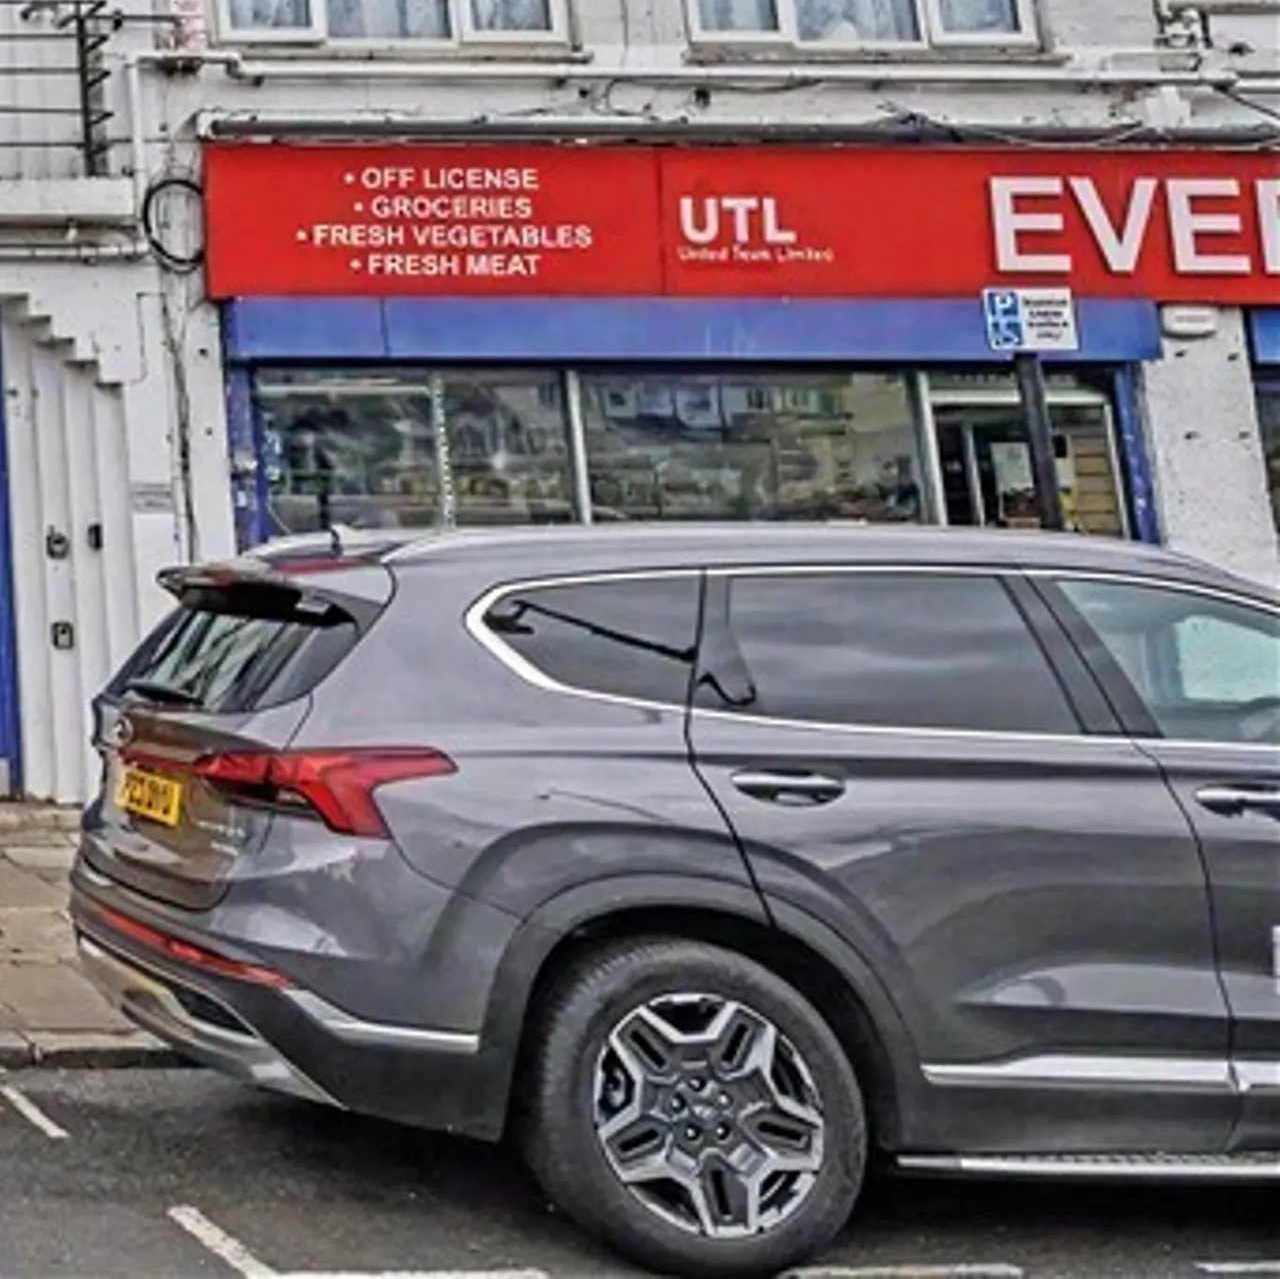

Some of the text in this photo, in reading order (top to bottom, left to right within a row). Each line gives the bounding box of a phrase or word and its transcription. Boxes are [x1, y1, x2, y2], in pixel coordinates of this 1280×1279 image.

[360, 167, 540, 190] OFF LICENSE
[371, 196, 533, 219] GROCERIES
[679, 196, 797, 244] UTL
[312, 224, 593, 248] FRESH VEGETABLES
[367, 253, 542, 276] FRESH MEAT
